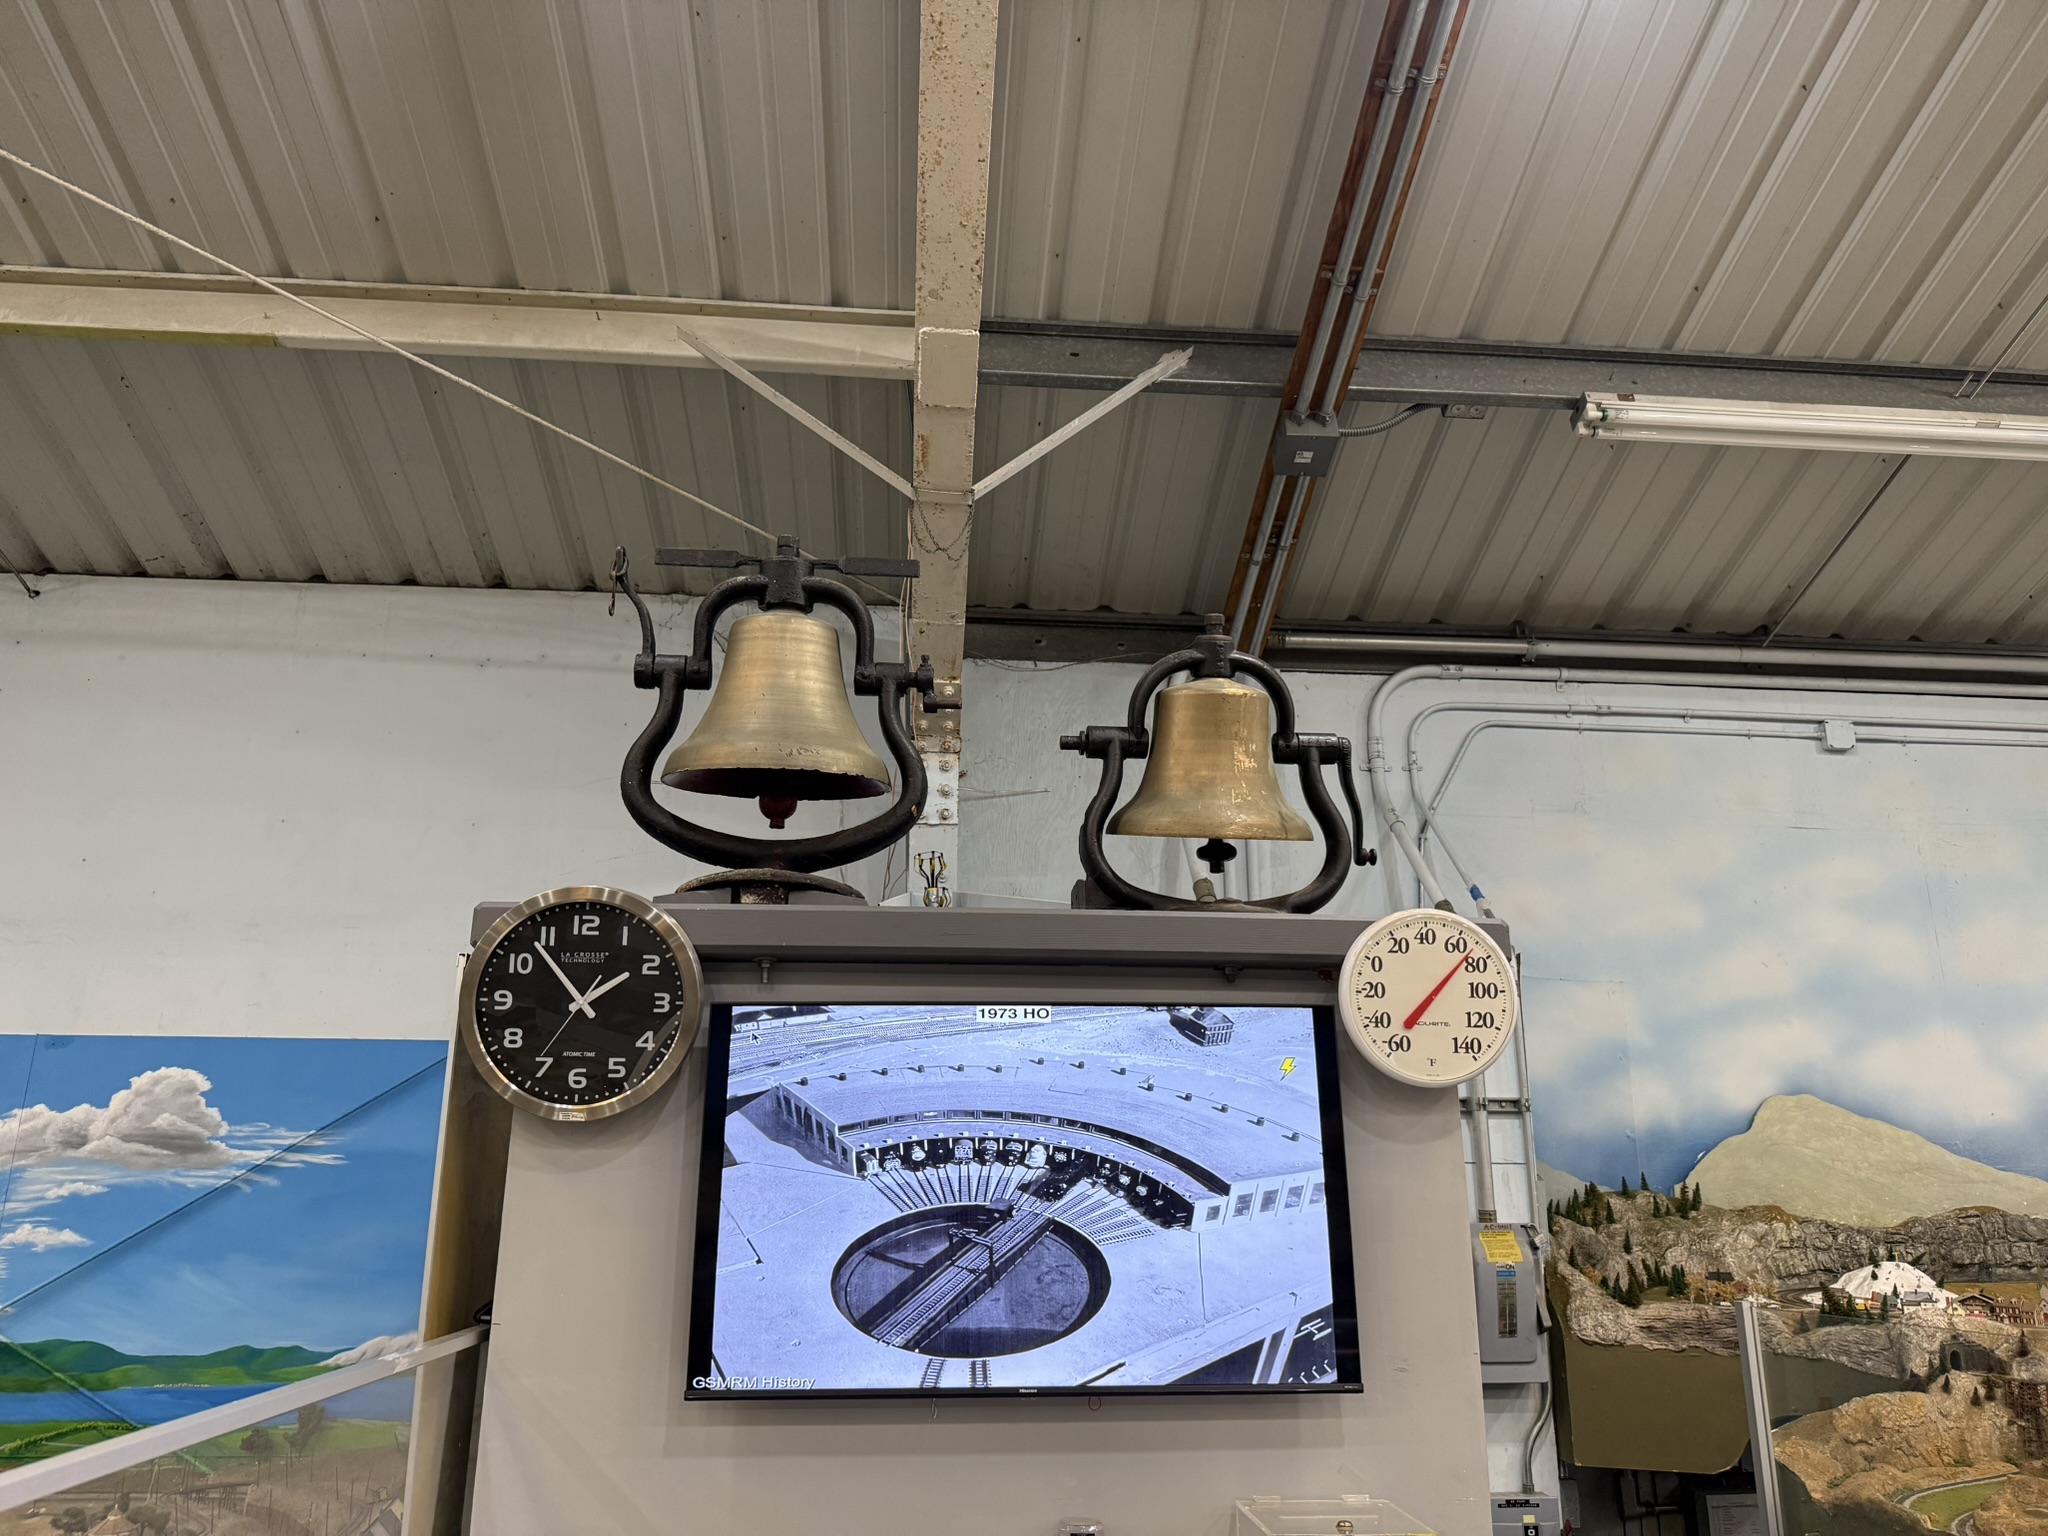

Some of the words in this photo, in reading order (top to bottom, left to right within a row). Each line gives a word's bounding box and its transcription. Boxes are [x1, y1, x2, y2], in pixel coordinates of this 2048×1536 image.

[573, 915, 600, 935] 12
[540, 926, 556, 946] 11
[622, 926, 629, 946] 1
[1414, 927, 1436, 945] 40
[1444, 935, 1467, 953] 60
[1387, 937, 1410, 954] 20
[508, 952, 533, 974] 10
[642, 955, 661, 975] 2
[1371, 956, 1383, 972] 0
[1464, 956, 1487, 973] 80
[1361, 981, 1386, 999] -20
[1468, 982, 1498, 999] 100
[493, 990, 513, 1010] 9
[653, 993, 671, 1013] 3
[978, 1008, 1018, 1019] 1973
[1024, 1008, 1050, 1019] HO
[1364, 1010, 1391, 1028] -40
[1465, 1011, 1494, 1028] 120
[503, 1028, 523, 1048] 8
[635, 1031, 655, 1051] 4
[1382, 1034, 1411, 1052] -60
[1452, 1036, 1482, 1054] 140
[535, 1057, 554, 1078] 7
[608, 1058, 626, 1078] 5
[568, 1068, 587, 1088] 6
[692, 1376, 758, 1389] GSMRM
[762, 1376, 816, 1390] History
